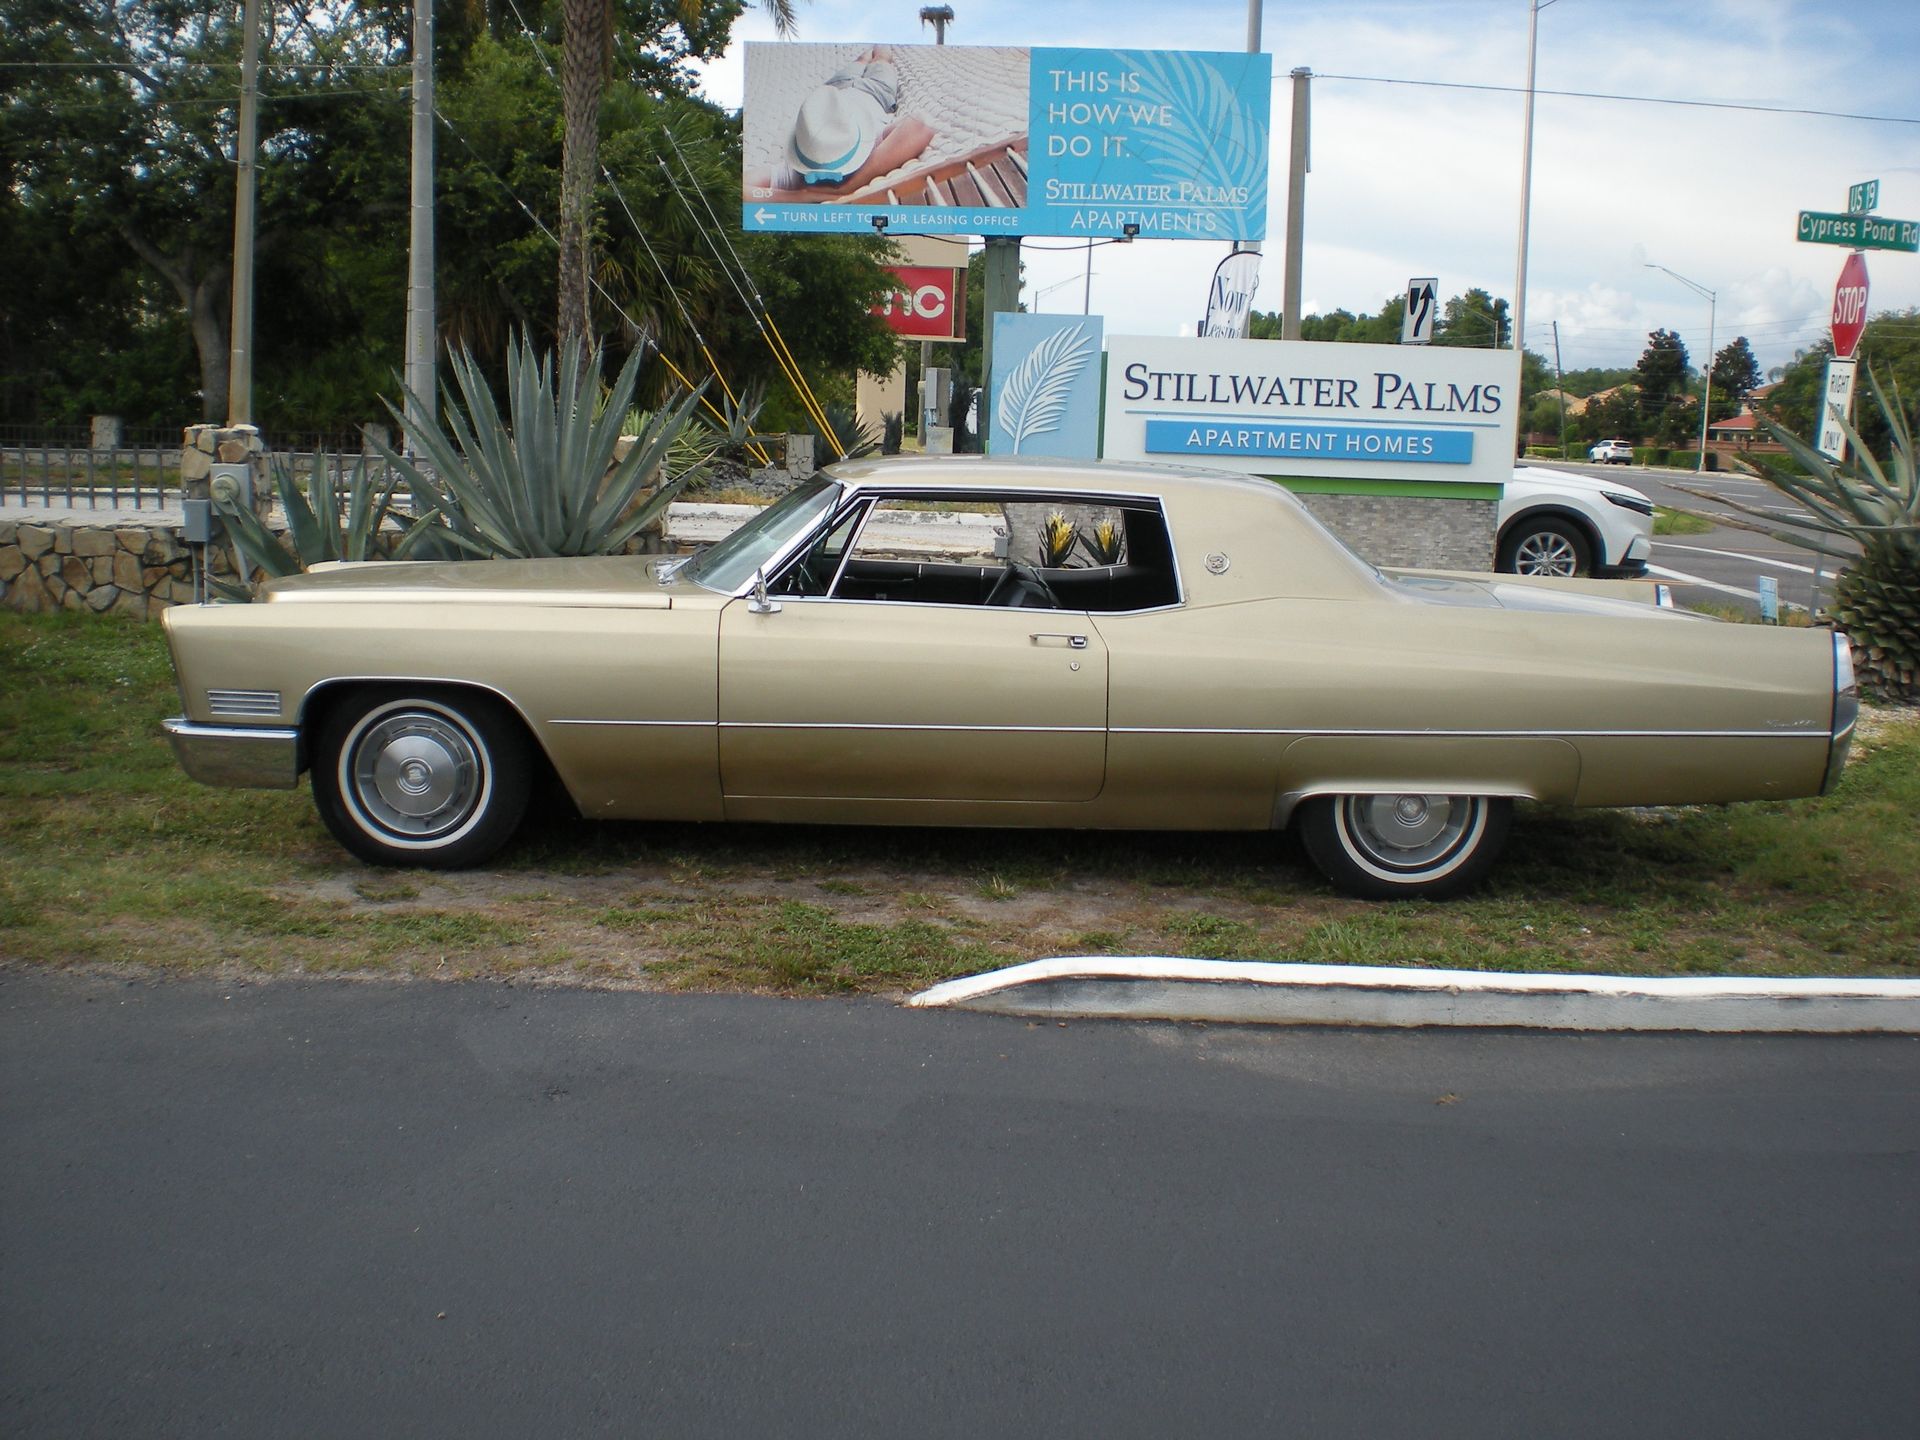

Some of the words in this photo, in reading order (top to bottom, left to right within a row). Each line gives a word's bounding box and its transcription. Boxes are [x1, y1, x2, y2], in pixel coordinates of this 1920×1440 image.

[1048, 70, 1109, 93] THIS
[1120, 71, 1141, 93] IS
[1049, 102, 1122, 125] HOW
[1128, 104, 1173, 127] WE
[1048, 135, 1092, 157] DO
[1103, 136, 1130, 157] IT.
[1045, 178, 1172, 202] STILLWATER
[1177, 180, 1249, 204] PALMS
[1850, 185, 1863, 212] US
[1865, 182, 1876, 209] 19
[781, 211, 818, 223] TURN
[823, 211, 852, 223] LEFT
[856, 212, 873, 224] TO
[913, 213, 968, 226] LEASING
[973, 214, 1019, 227] OFFICE
[1070, 209, 1217, 232] APARTMENTS
[1799, 213, 1857, 241] Cypress
[1862, 218, 1897, 242] Pond
[1901, 223, 1919, 244] Rd
[1834, 286, 1867, 324] STOP
[1123, 362, 1360, 408] STILLWATER
[1371, 372, 1501, 414] PALMS
[1830, 374, 1850, 394] RIGHT
[1186, 428, 1338, 451] APARTMENT
[1345, 434, 1434, 455] HOMES
[1823, 430, 1842, 451] ONLY
